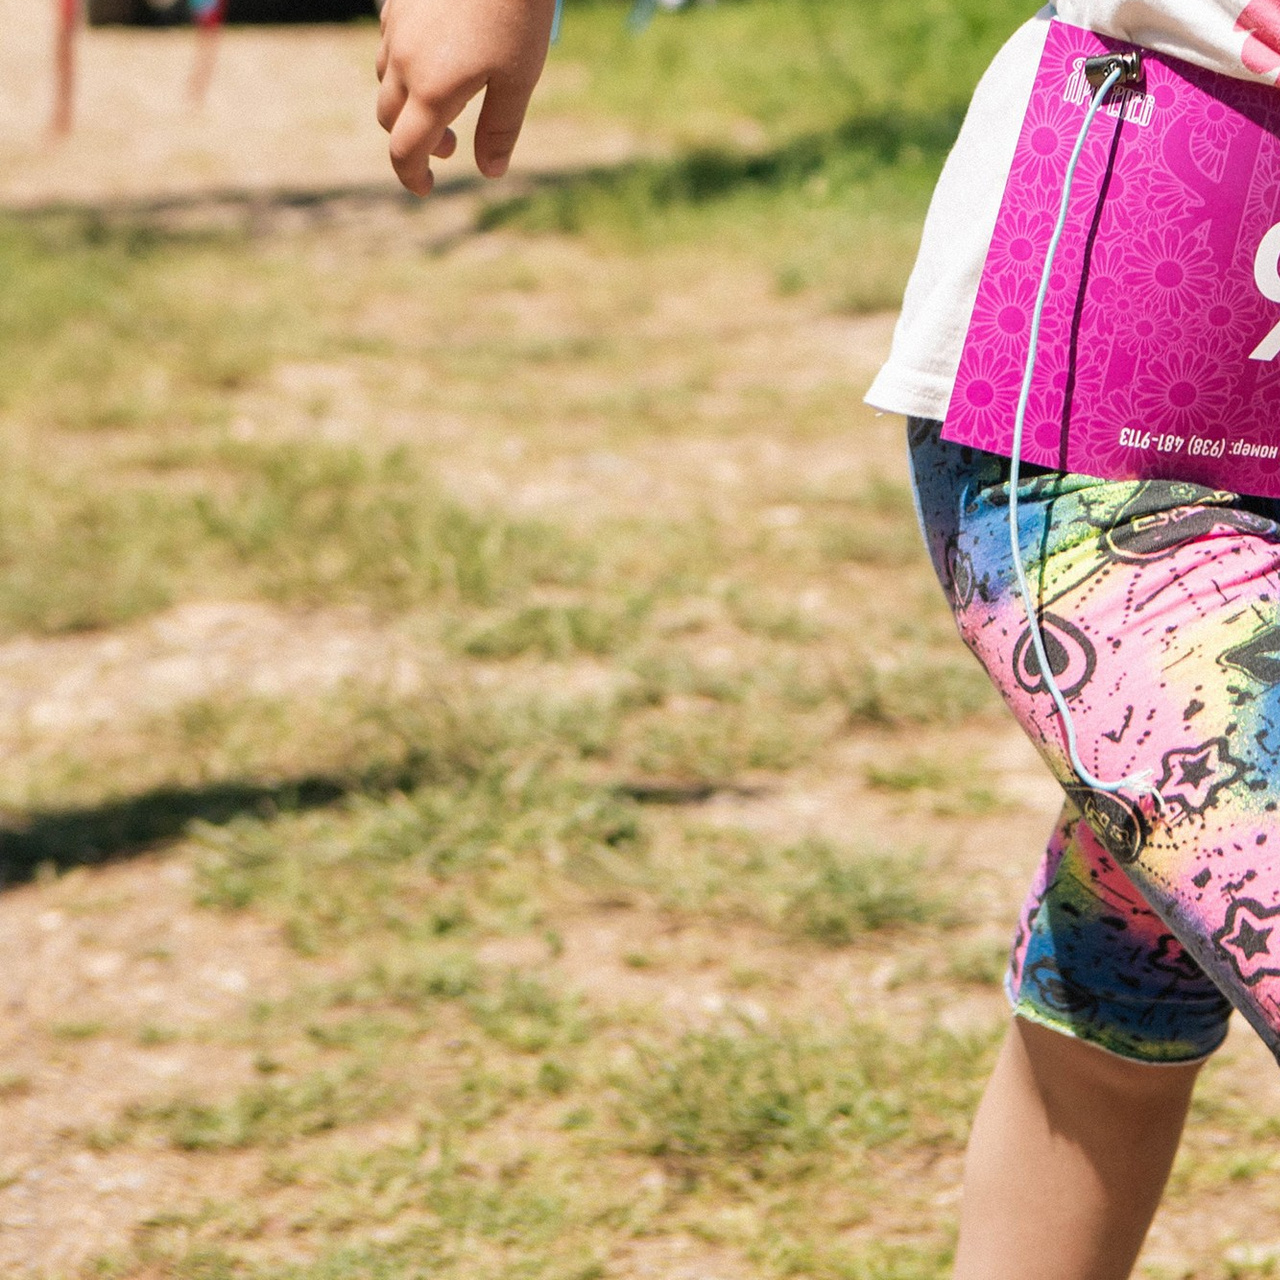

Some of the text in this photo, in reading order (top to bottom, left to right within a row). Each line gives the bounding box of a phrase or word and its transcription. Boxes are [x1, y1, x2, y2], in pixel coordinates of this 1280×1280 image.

[1118, 427, 1185, 453] 481-9113
[1187, 434, 1227, 459] (938)
[1228, 438, 1278, 459] номер:
